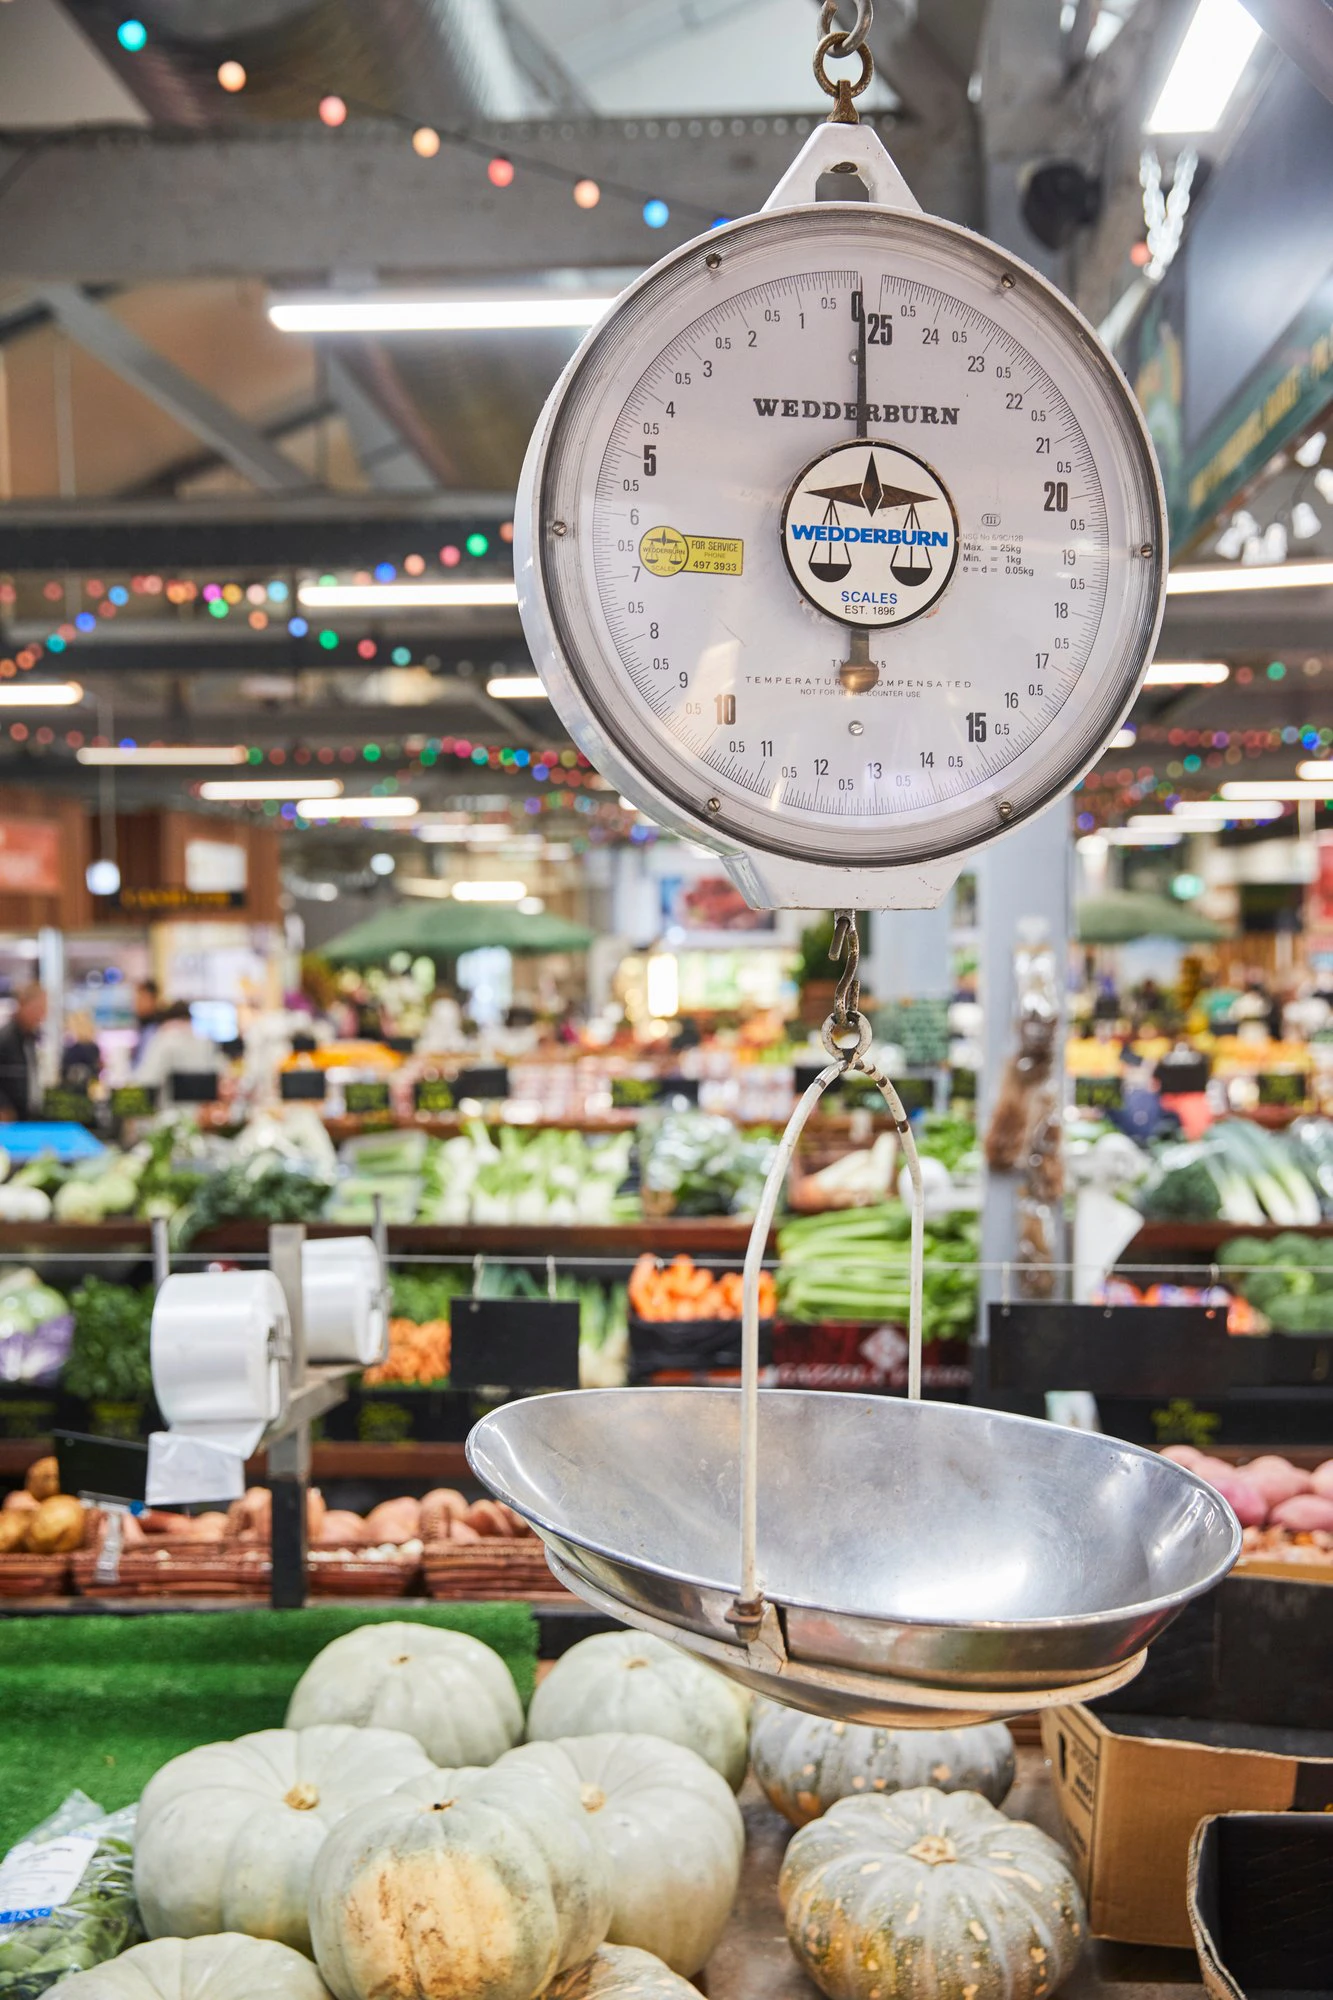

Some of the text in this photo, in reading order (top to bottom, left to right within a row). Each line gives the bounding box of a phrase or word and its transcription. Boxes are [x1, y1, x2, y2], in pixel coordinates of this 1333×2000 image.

[821, 298, 836, 310] 0.5
[851, 291, 863, 322] 0
[764, 310, 780, 322] 0.5
[901, 305, 916, 317] 0.5
[799, 313, 805, 329] 1
[868, 313, 892, 346] 25
[748, 331, 757, 348] 2
[922, 328, 939, 345] 24
[952, 331, 967, 343] 0.5
[716, 337, 731, 350] 0.5
[703, 360, 713, 377] 3
[968, 356, 985, 372] 23
[996, 366, 1011, 378] 0.5
[675, 373, 691, 385] 0.5
[1006, 394, 1023, 410] 22
[666, 401, 676, 418] 4
[753, 398, 960, 425] WEDDERBURN
[1032, 410, 1046, 422] 0.5
[643, 423, 659, 435] 0.5
[1036, 438, 1051, 454] 21
[643, 444, 656, 476] 5
[1057, 462, 1072, 474] 0.5
[623, 480, 639, 492] 0.5
[1044, 482, 1068, 512] 20
[630, 509, 639, 525] 6
[1070, 519, 1085, 531] 0.5
[791, 524, 948, 547] WEDDERBURN
[618, 540, 634, 552] 0.5
[643, 547, 685, 555] WEDDERBURN
[692, 540, 738, 552] FOR SERVICE
[963, 543, 983, 551] Max.
[1000, 544, 1021, 554] 25kg
[963, 554, 981, 562] Min.
[1007, 556, 1022, 565] 1kg
[1062, 549, 1076, 566] 19
[693, 561, 737, 571] 497 3933
[1006, 567, 1034, 576] 0.05kg
[632, 567, 640, 583] 7
[1070, 579, 1085, 591] 0.5
[841, 591, 898, 604] SCALES
[628, 602, 644, 614] 0.5
[845, 605, 896, 616] EST. 1896
[1054, 603, 1068, 619] 18
[650, 622, 659, 639] 8
[1054, 638, 1070, 649] 0.5
[653, 658, 669, 670] 0.5
[1036, 653, 1049, 669] 17
[679, 672, 688, 688] 9
[746, 676, 972, 688] TEMPERATUR OMPENSATED
[1029, 685, 1043, 696] 0.5
[1005, 693, 1019, 709] 16
[686, 703, 701, 715] 0.5
[714, 694, 736, 725] 10
[966, 712, 987, 743] 15
[995, 724, 1010, 735] 0.5
[729, 741, 745, 753] 0.5
[761, 741, 773, 757] 11
[920, 752, 935, 768] 14
[948, 756, 963, 768] 0.5
[782, 766, 797, 778] 0.5
[814, 759, 829, 776] 12
[868, 763, 882, 779] 13
[838, 779, 854, 791] 0.5
[896, 775, 911, 787] 0.5
